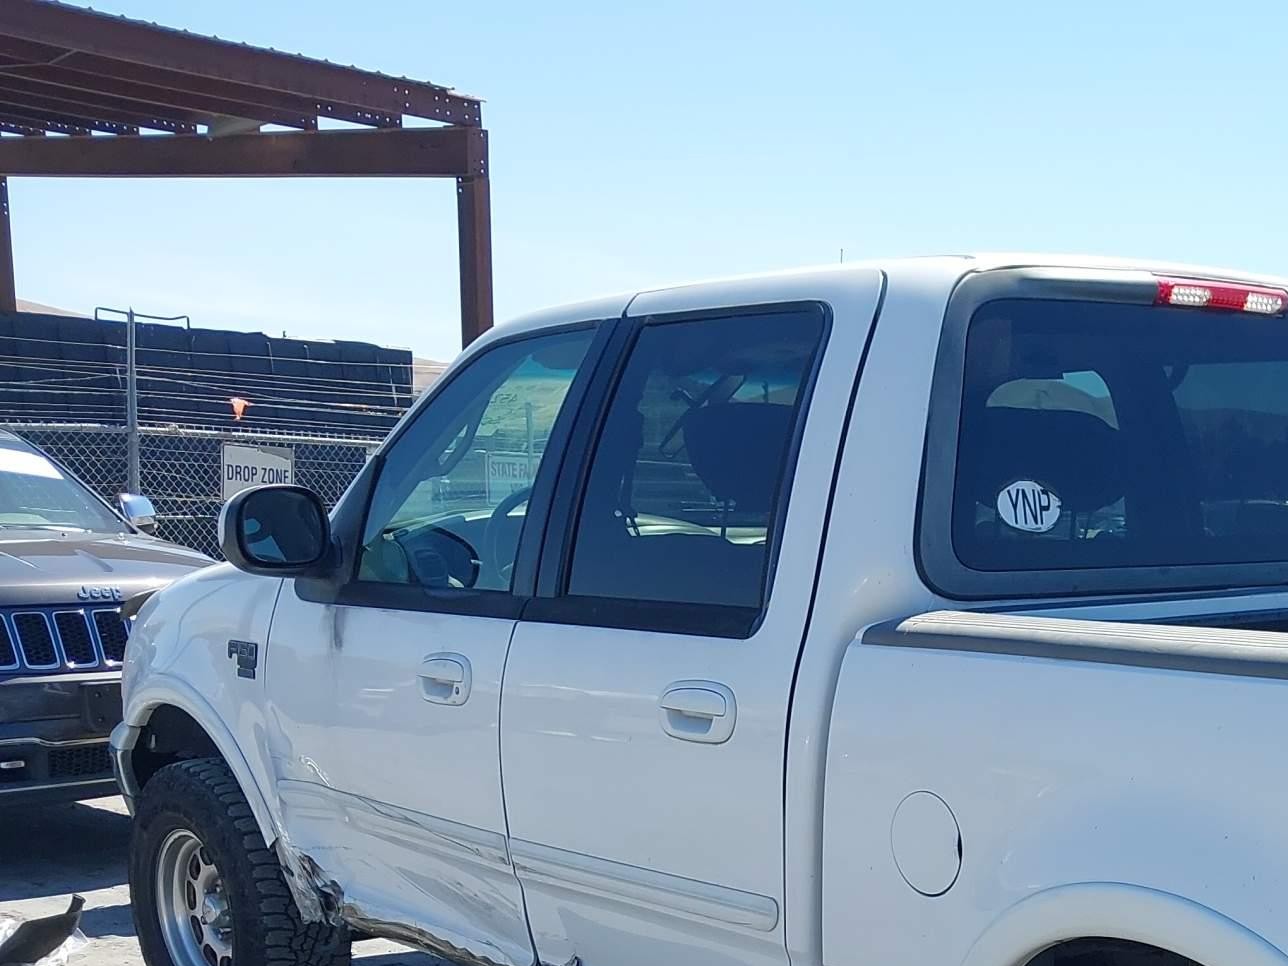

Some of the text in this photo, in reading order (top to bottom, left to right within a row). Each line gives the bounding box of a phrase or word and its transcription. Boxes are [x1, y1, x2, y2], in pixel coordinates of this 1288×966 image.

[226, 464, 289, 484] DROP ZONE
[489, 461, 517, 478] STATE
[1007, 488, 1050, 525] YNP
[77, 586, 121, 601] Jeep
